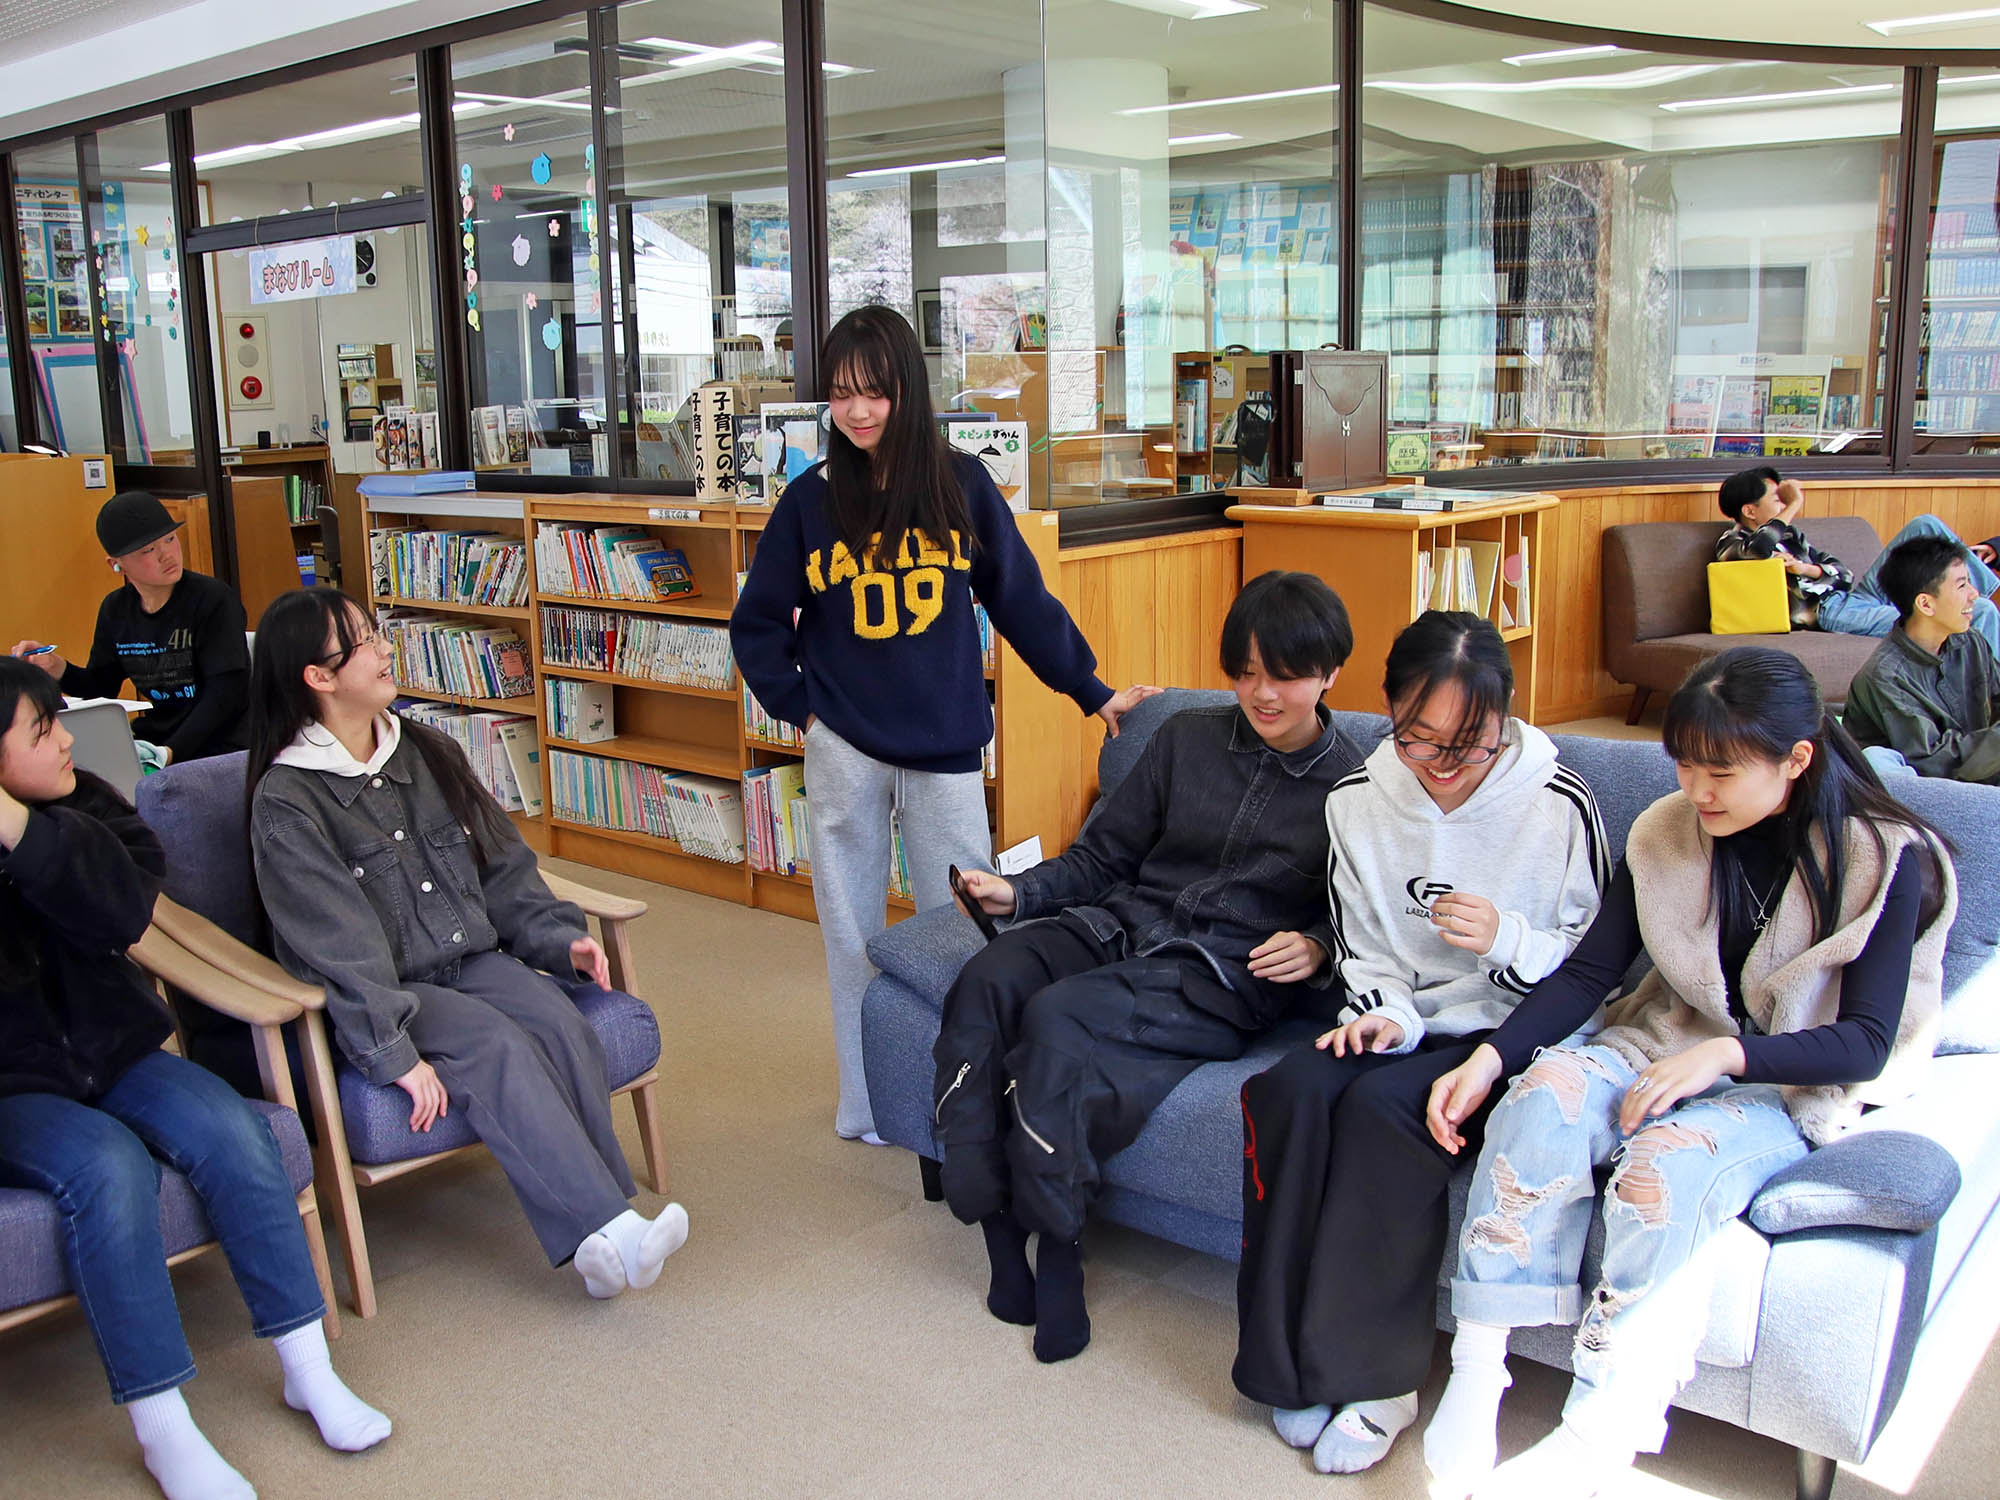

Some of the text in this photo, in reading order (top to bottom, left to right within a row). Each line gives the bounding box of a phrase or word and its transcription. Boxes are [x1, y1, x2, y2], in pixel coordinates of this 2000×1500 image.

[263, 256, 335, 295] まなびルーム
[692, 392, 706, 494] 子育ての本
[713, 391, 736, 493] 子育ての本
[957, 428, 1020, 440] 大ピンチずかん
[850, 566, 945, 640] 09
